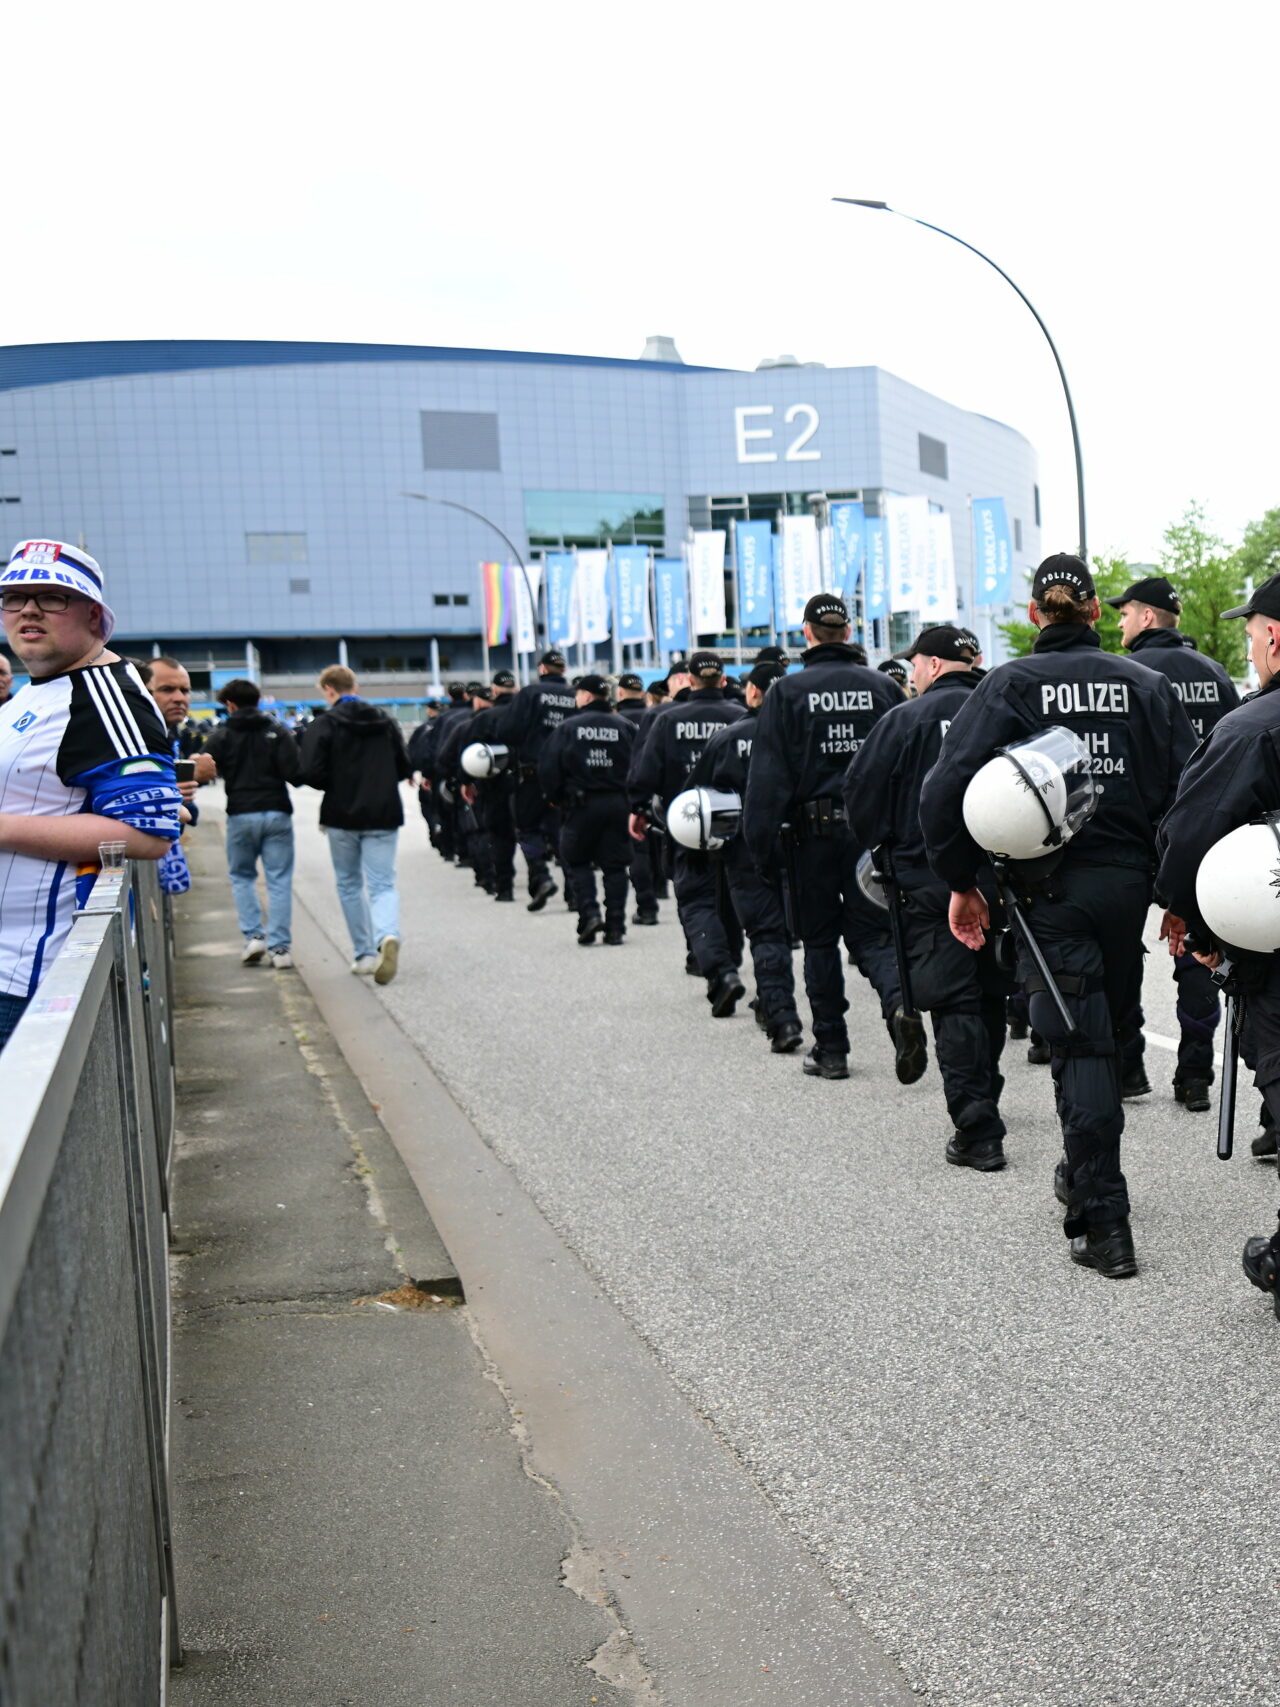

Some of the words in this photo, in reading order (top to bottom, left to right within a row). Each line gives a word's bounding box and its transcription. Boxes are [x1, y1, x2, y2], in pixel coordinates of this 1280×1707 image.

[735, 404, 822, 464] E2
[897, 511, 911, 579] BARCLAYS
[982, 509, 997, 575] BARCLAYS
[743, 536, 756, 597] BARCLAYS
[1041, 571, 1082, 586] POLIZEI
[816, 604, 845, 614] POLIZEI
[808, 691, 873, 713] POLIZEI
[1041, 682, 1129, 715] POLIZEI
[577, 726, 619, 742] POLIZEI
[828, 724, 854, 739] HH
